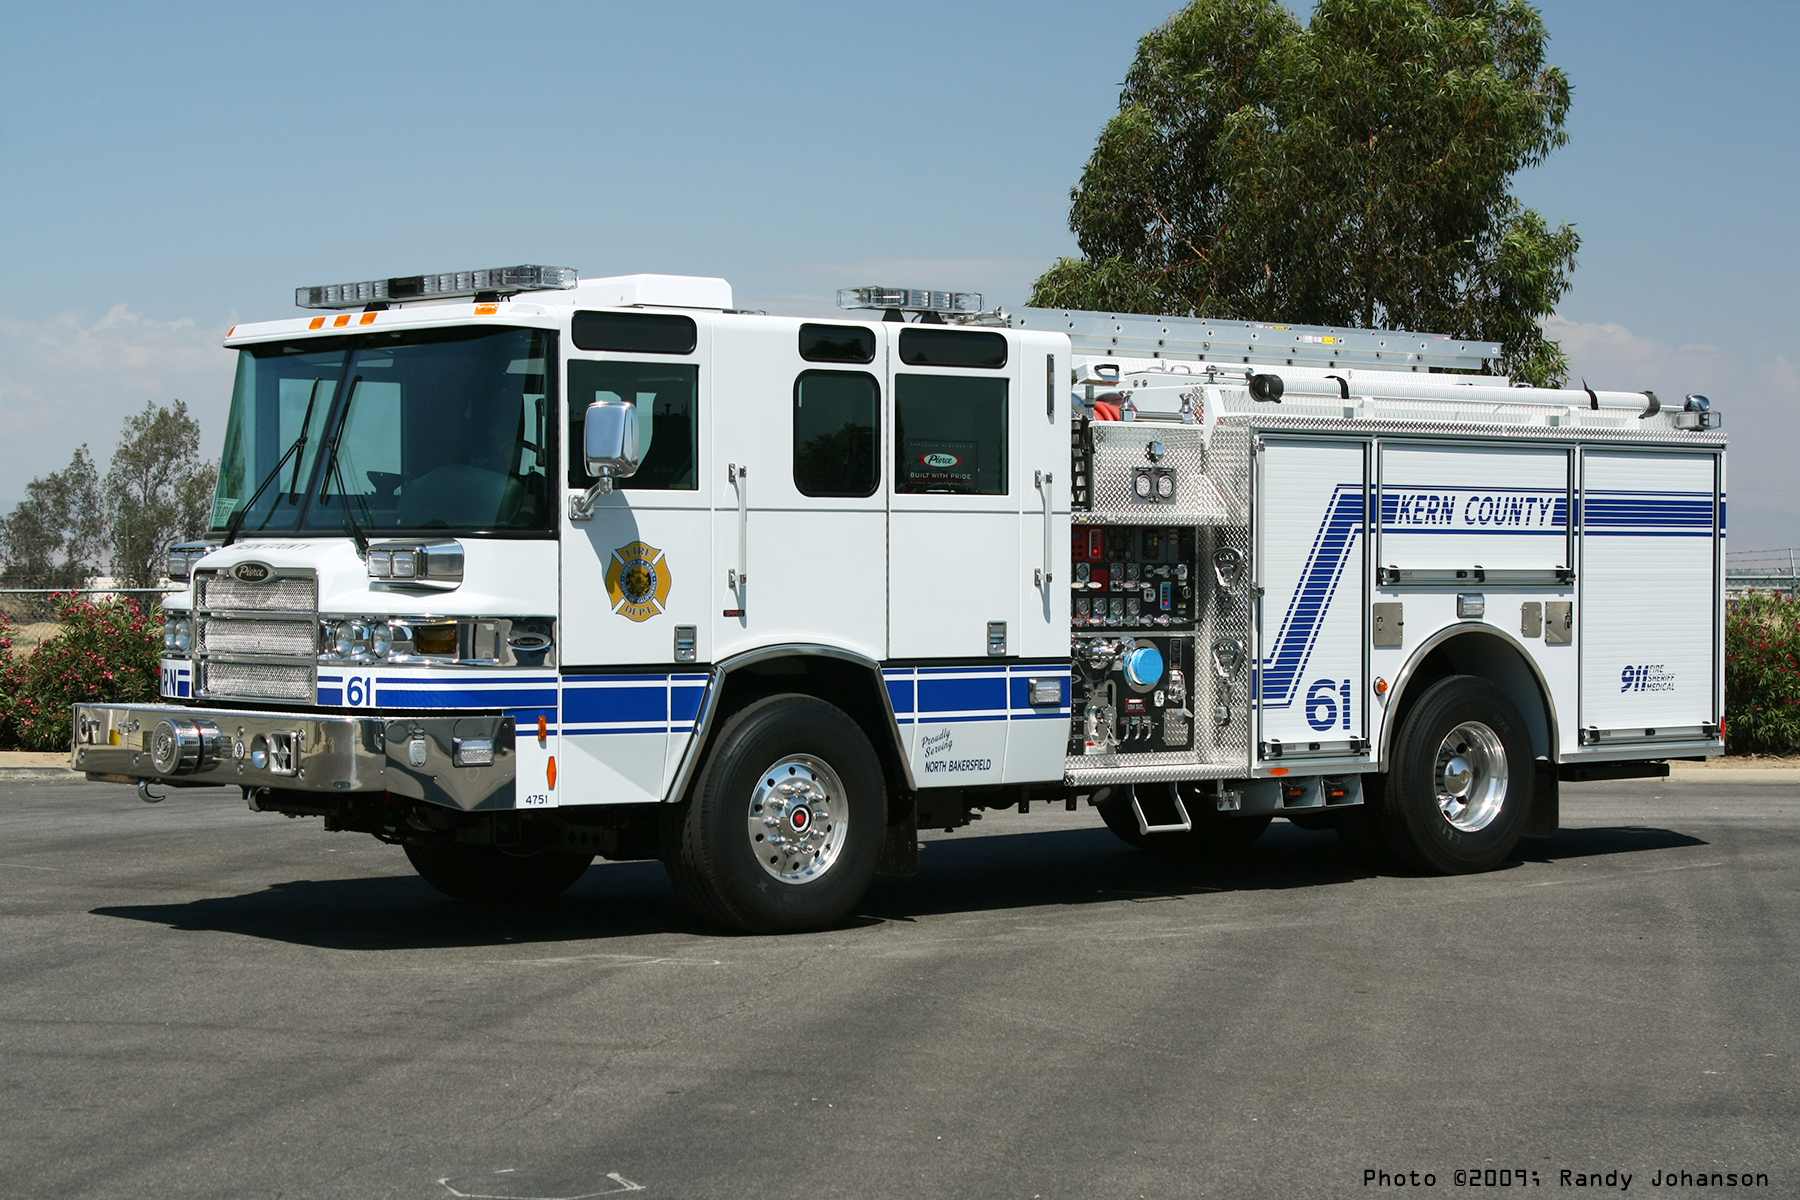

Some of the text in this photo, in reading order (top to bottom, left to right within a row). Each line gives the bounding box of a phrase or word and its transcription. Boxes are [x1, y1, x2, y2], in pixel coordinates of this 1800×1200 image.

[927, 454, 954, 465] Pierce
[910, 471, 930, 479] BUILT
[1397, 494, 1553, 526] KERN COUNTY
[625, 546, 653, 558] FIRE
[238, 564, 265, 578] Pierce
[1620, 664, 1665, 693] 911 FIRE
[1647, 673, 1675, 682] SHERIFF
[346, 676, 372, 707] 61
[1645, 682, 1675, 692] MEDICAL
[1305, 678, 1351, 732] 61
[920, 727, 951, 749] Proudly
[924, 739, 953, 758] Serving
[925, 759, 992, 773] NORTH BAKERSFIELD
[525, 794, 548, 805] 4751
